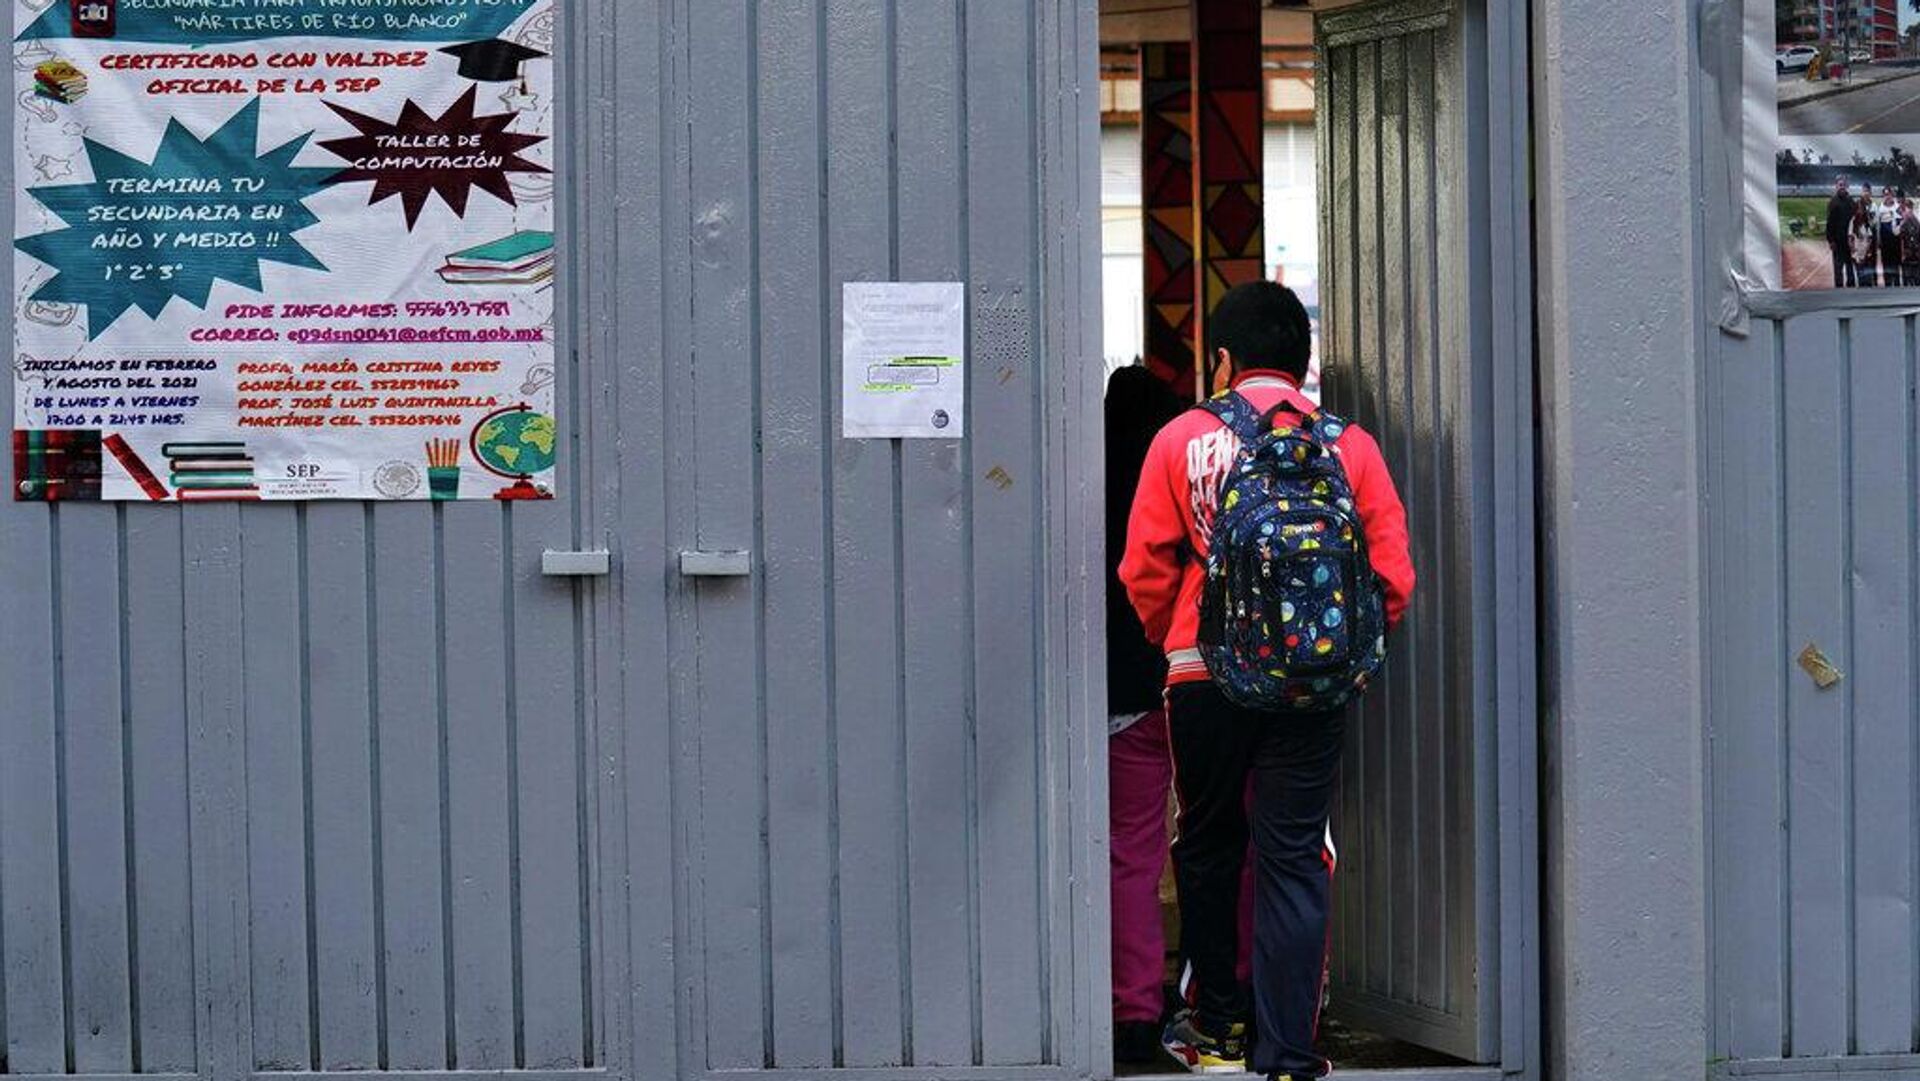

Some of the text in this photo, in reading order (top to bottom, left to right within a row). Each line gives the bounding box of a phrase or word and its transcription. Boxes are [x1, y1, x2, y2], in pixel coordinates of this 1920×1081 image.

[302, 14, 324, 29] DE
[385, 12, 467, 29] BLANCO"
[100, 51, 429, 70] CERTIFICADO CON VALIDEZ
[146, 78, 381, 94] OFICIAL DE LA SEP
[375, 134, 482, 148] TALLER DE
[354, 150, 503, 170] COMPUTACIÓN
[106, 177, 265, 193] TERMINA TU
[87, 205, 284, 222] SECUNDARIA EN
[91, 228, 280, 249] AÑO Y MEDIO !!
[225, 304, 275, 319] PIDE
[280, 303, 398, 319] INFORMES:
[190, 328, 280, 342] CORREO:
[23, 360, 217, 372] INICIAMOS EN FEBRERO
[302, 358, 359, 373] MARÍA
[366, 362, 443, 373] CRISTINA
[451, 360, 501, 372] REYES
[43, 377, 198, 390] Y AGOSTO DEL 2021
[238, 376, 326, 392] GONZÁLEZ
[34, 396, 200, 409] DE LUNES A VIERNES
[290, 393, 334, 409] JOSÉ
[340, 397, 380, 409] LUIS
[384, 396, 497, 408] QUINTANILLA
[91, 415, 103, 425] A
[109, 415, 147, 425] 21:45
[151, 414, 186, 425] HRS.
[238, 411, 326, 427] MARTÍNEZ
[286, 463, 321, 478] SEP
